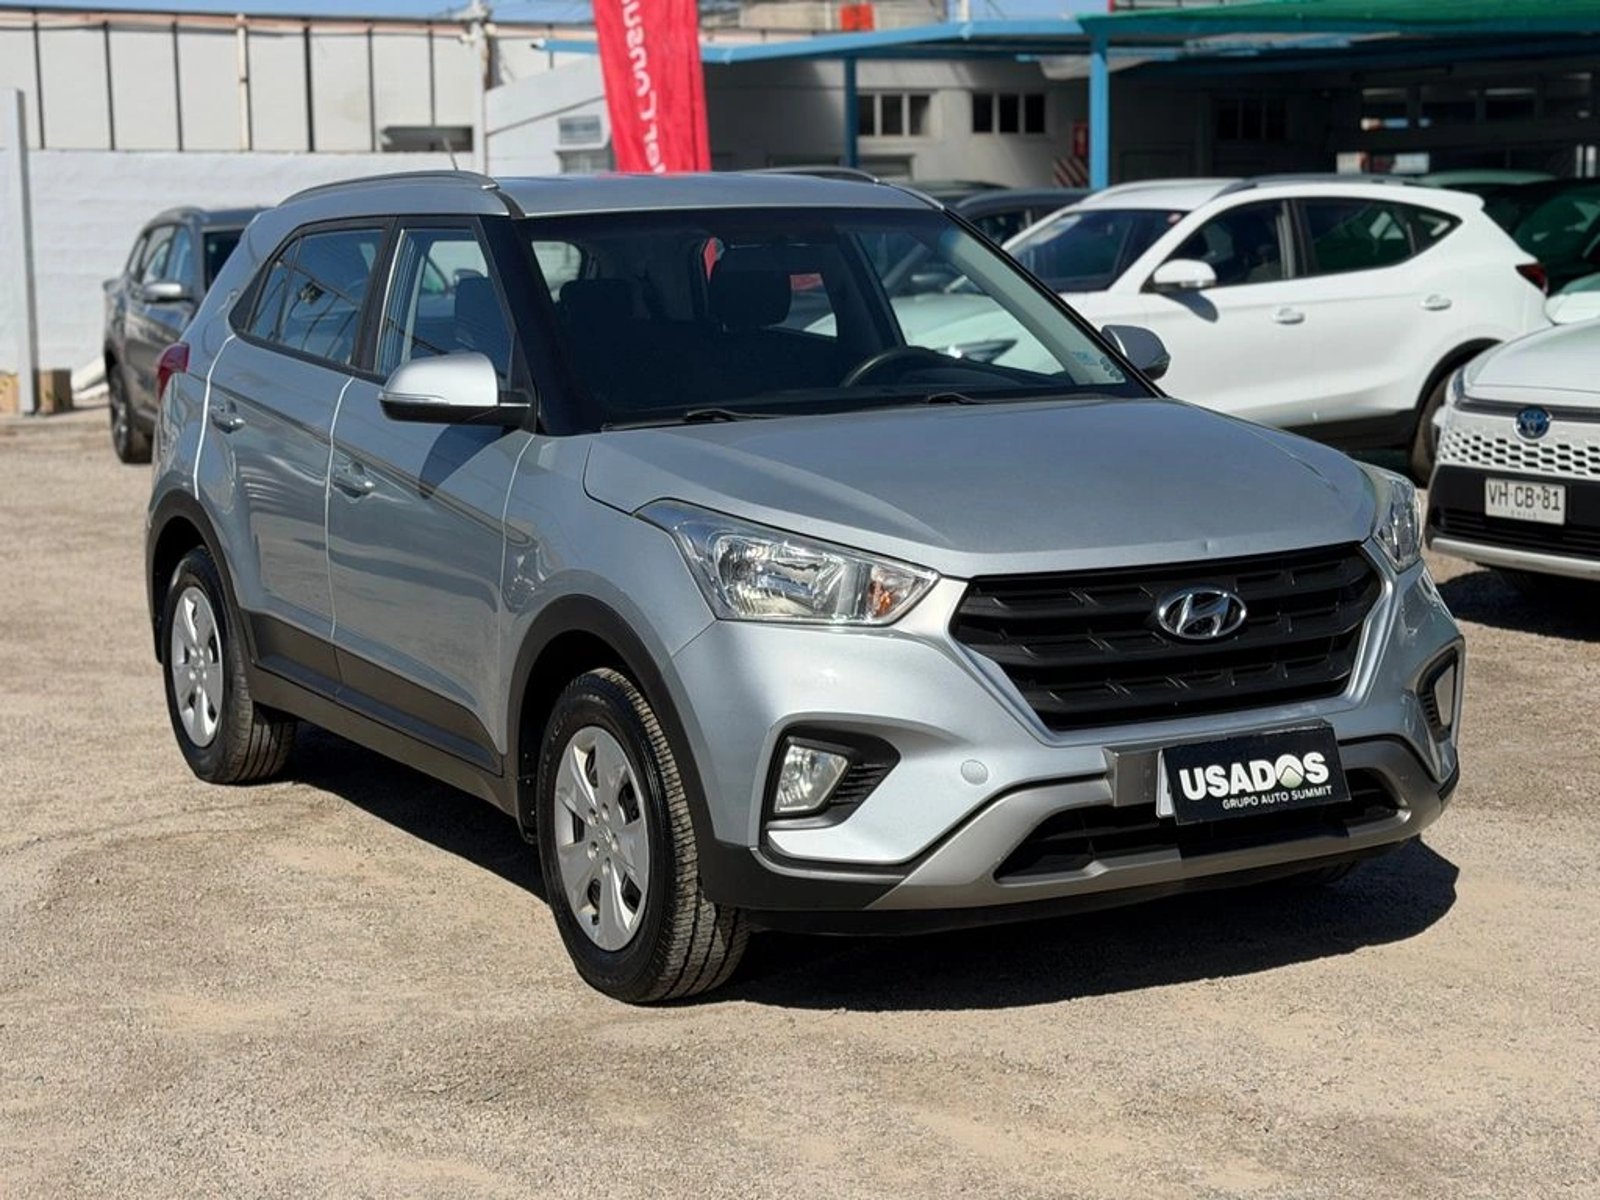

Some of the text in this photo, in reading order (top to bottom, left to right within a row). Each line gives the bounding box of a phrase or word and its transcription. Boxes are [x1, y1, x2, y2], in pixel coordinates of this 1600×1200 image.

[1179, 751, 1330, 801] USADOS
[1222, 785, 1333, 810] GRUPO AUTO SUMMIT
